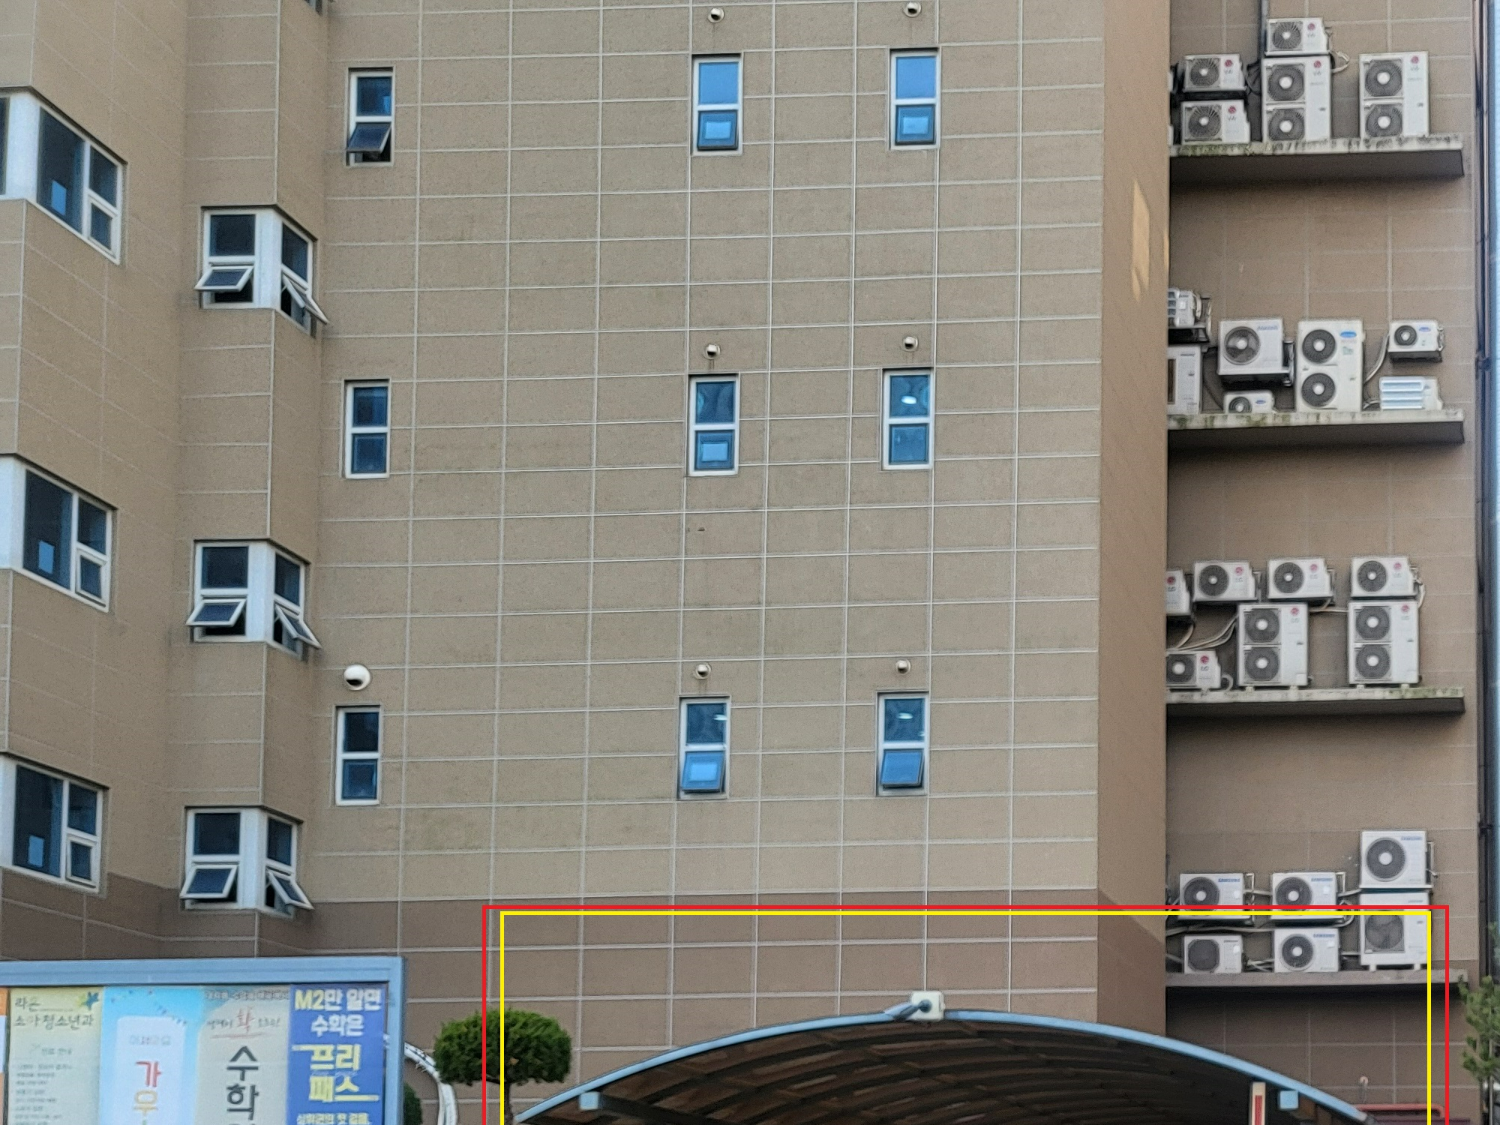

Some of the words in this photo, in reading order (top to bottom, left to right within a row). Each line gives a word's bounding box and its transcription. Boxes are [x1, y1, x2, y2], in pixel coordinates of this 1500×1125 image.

[295, 989, 342, 1011] M2만
[311, 1014, 364, 1037] 수학은
[292, 1044, 361, 1071] 프리
[309, 1075, 379, 1103] 패스
